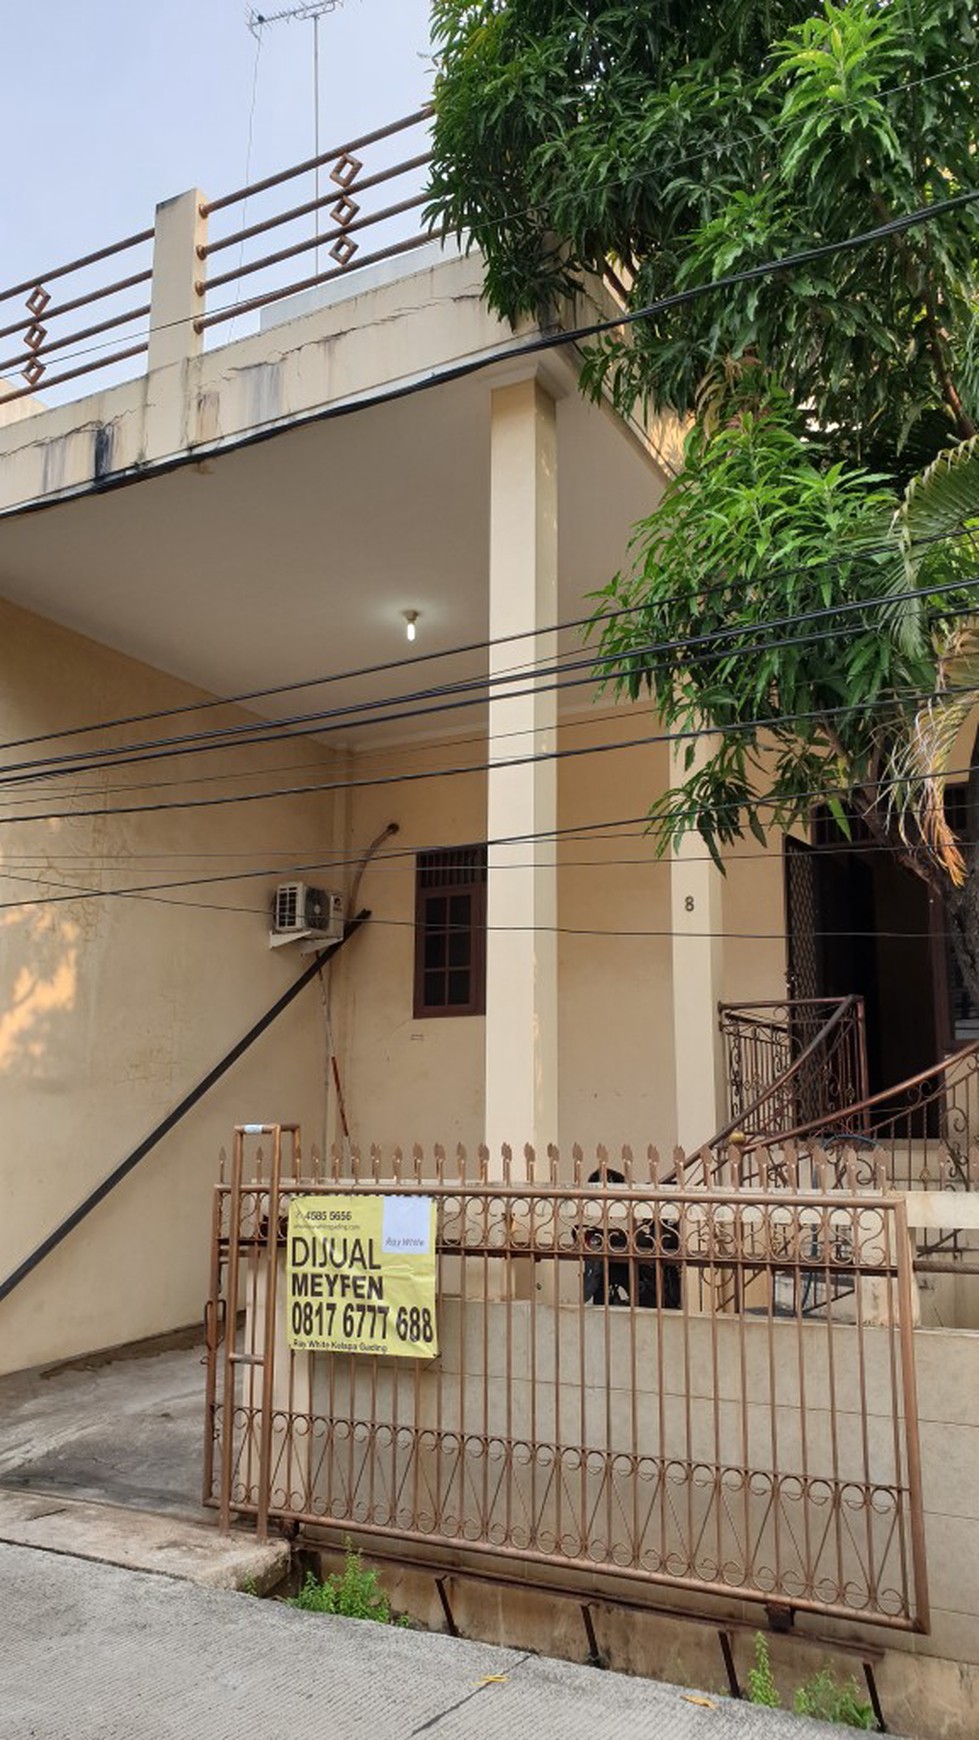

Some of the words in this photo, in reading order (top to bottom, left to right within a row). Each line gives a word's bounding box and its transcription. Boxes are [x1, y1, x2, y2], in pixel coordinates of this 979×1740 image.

[685, 895, 694, 912] 8
[292, 1236, 381, 1270] DIJUAL
[292, 1273, 383, 1300] MEYFEN
[292, 1301, 336, 1336] 0817
[343, 1303, 389, 1340] 6777
[396, 1306, 433, 1343] 688
[309, 1340, 329, 1348] White
